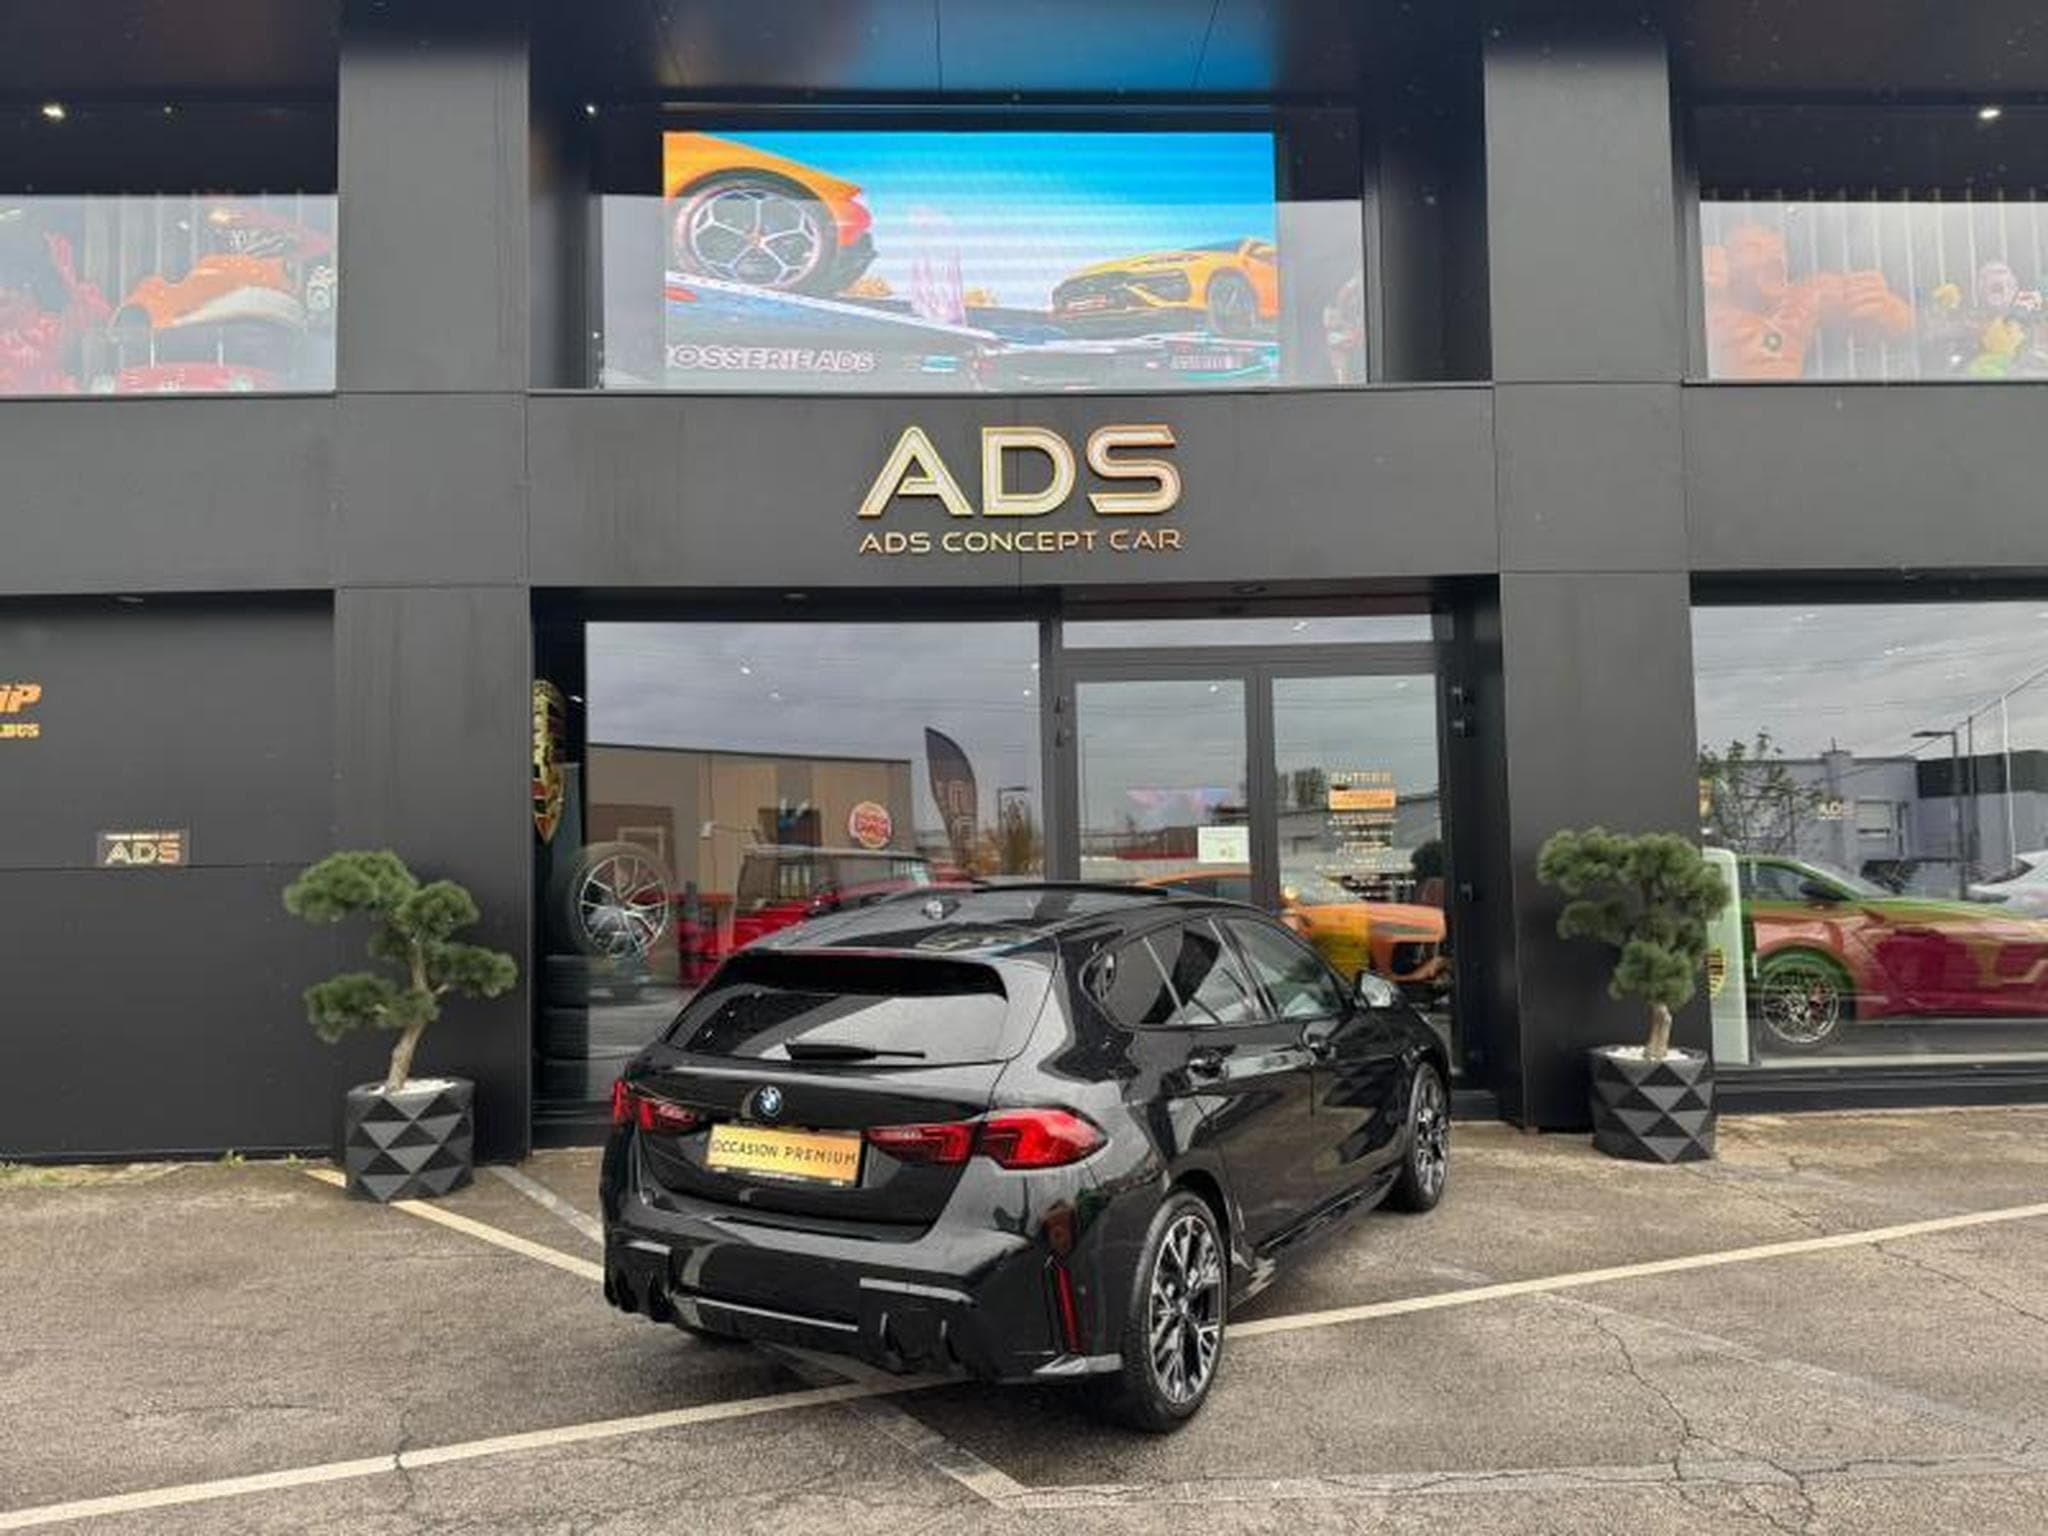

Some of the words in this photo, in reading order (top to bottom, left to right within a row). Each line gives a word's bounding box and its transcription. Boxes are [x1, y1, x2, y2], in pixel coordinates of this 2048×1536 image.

[858, 425, 1181, 517] ADS
[859, 532, 931, 553] ADS
[942, 531, 1097, 552] CONCEPT
[1109, 529, 1182, 550] CAR
[104, 841, 181, 865] ADS
[712, 1139, 778, 1157] OCCASION
[784, 1147, 856, 1166] PREMIUM
